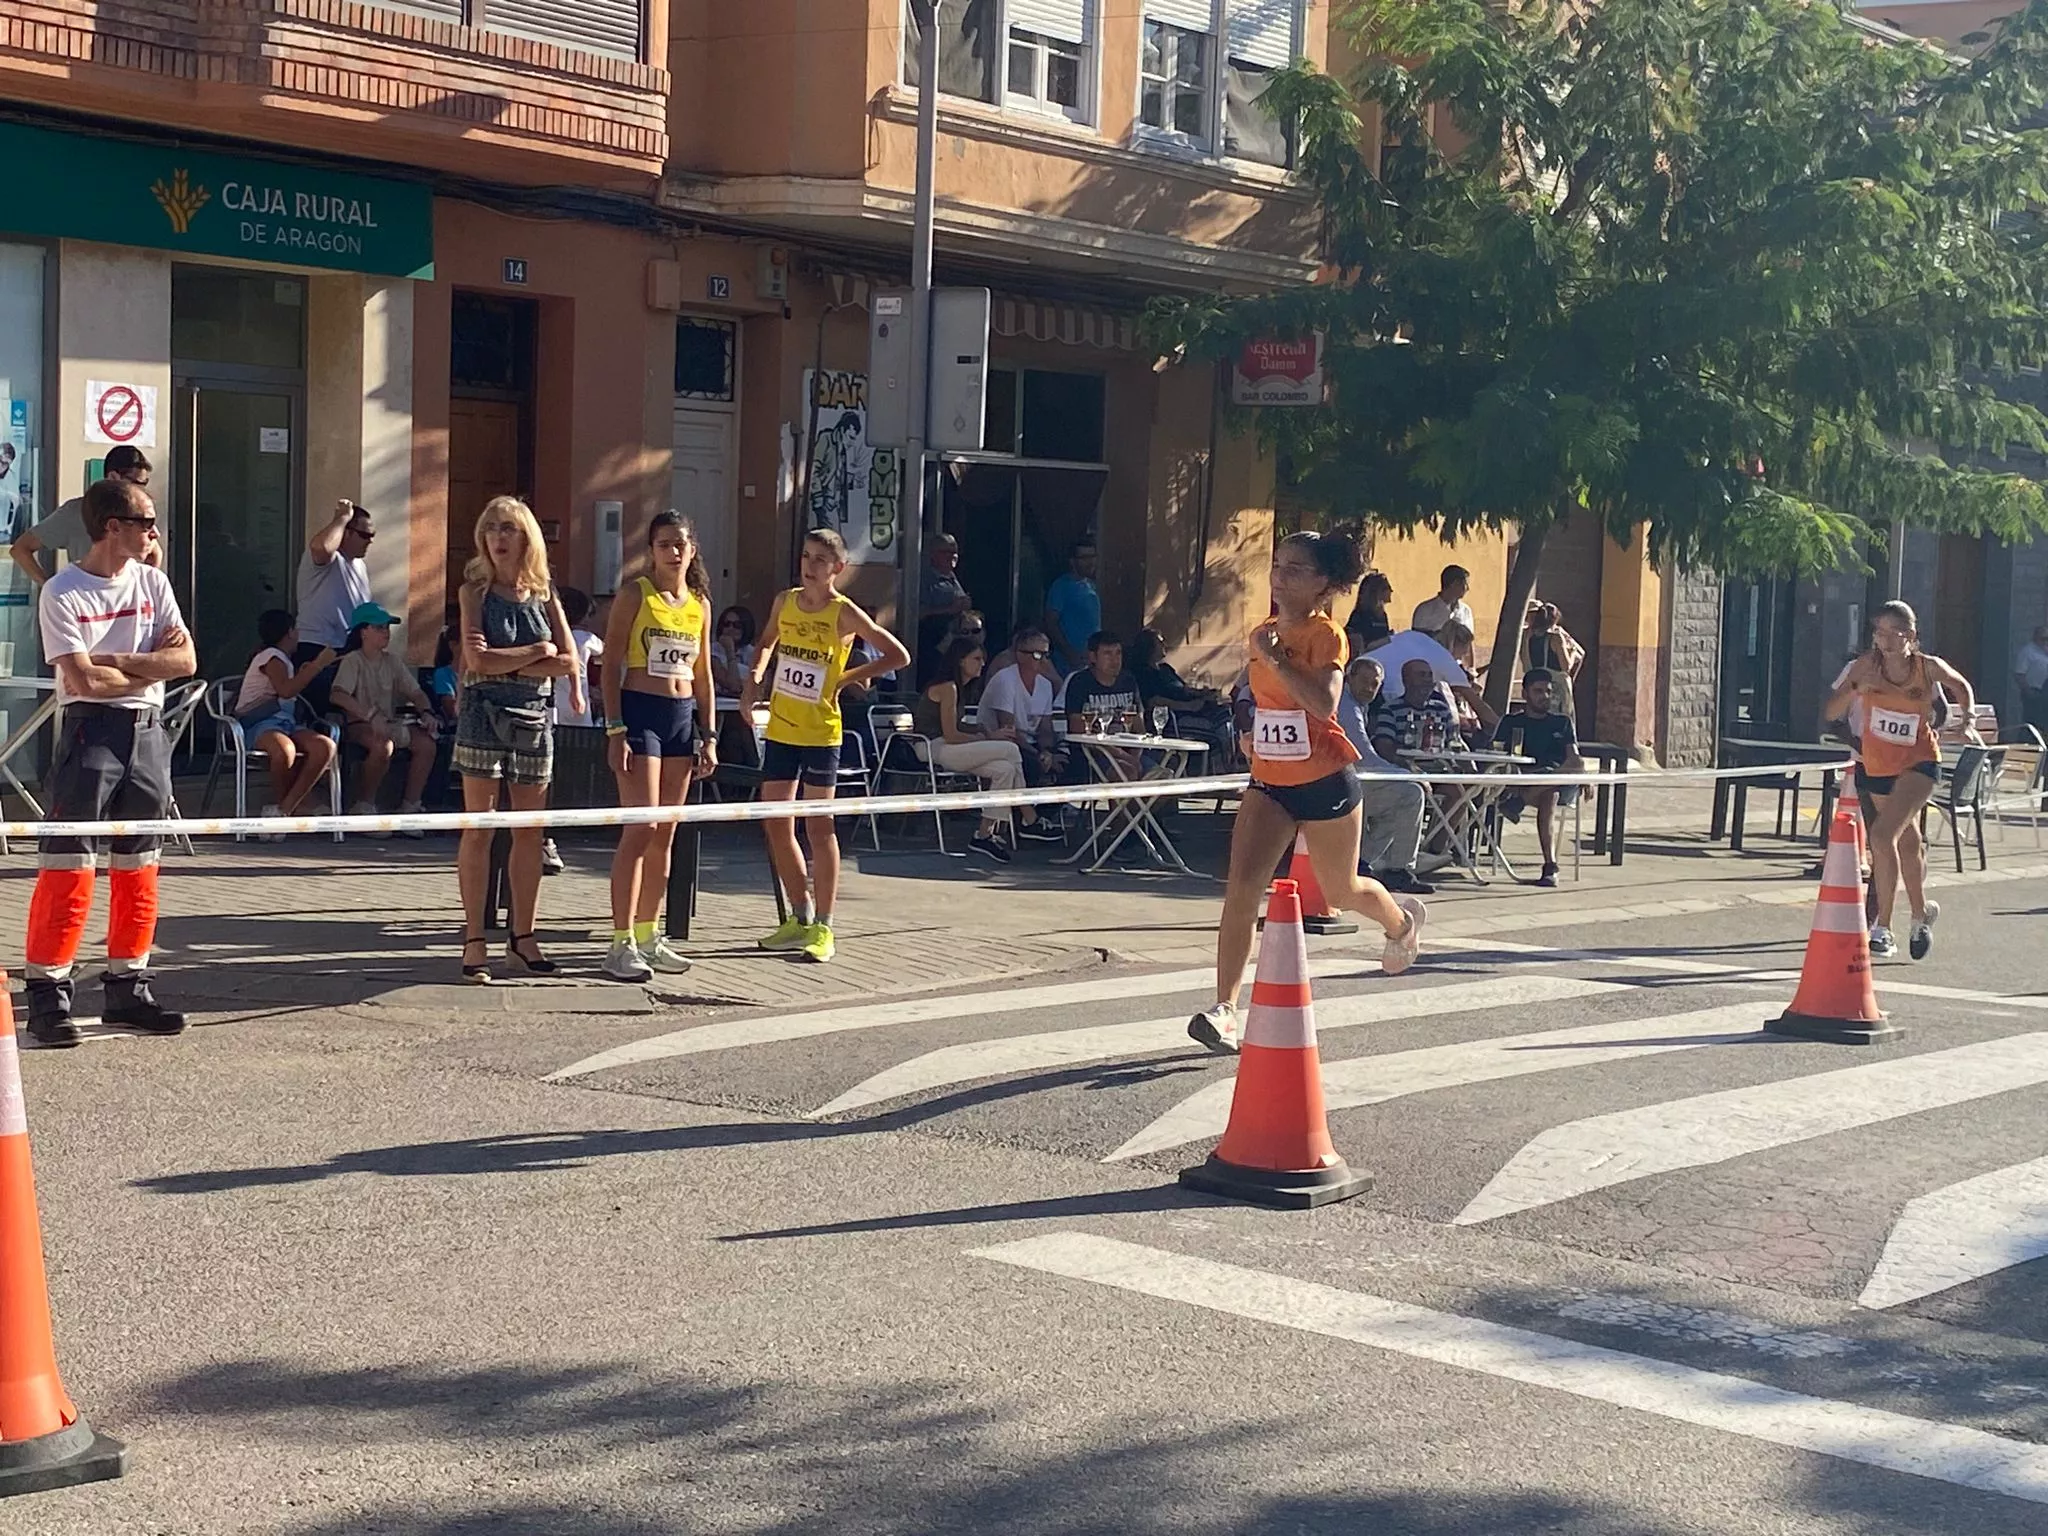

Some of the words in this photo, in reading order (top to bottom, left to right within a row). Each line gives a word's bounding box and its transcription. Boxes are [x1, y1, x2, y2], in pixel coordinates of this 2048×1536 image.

[222, 182, 287, 216] CAJA
[295, 191, 378, 228] RURAL
[240, 222, 267, 244] DE
[274, 226, 361, 255] ARAGÓN
[508, 261, 523, 281] 14
[713, 278, 726, 297] 12
[1260, 356, 1296, 370] Damm
[810, 371, 868, 411] BAR
[869, 448, 896, 550] OMBO
[784, 667, 815, 689] 103
[1262, 723, 1298, 743] 113
[1878, 719, 1910, 736] 108
